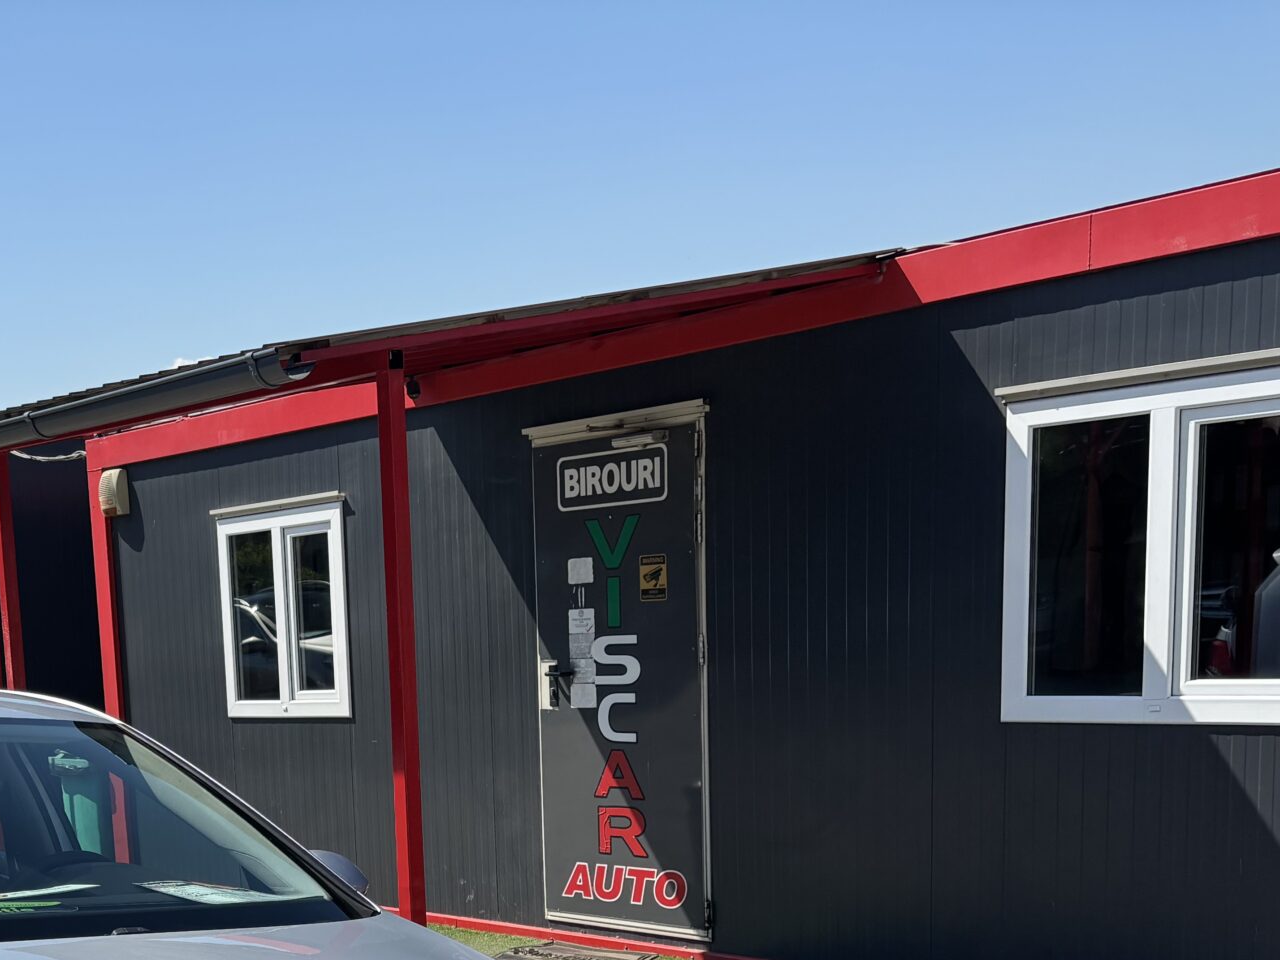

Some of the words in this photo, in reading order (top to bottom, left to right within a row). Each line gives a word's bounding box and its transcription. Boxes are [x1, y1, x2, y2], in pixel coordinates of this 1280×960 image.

[564, 456, 661, 499] BIROURI
[584, 514, 648, 858] VISCAR
[562, 861, 688, 910] AUTO
